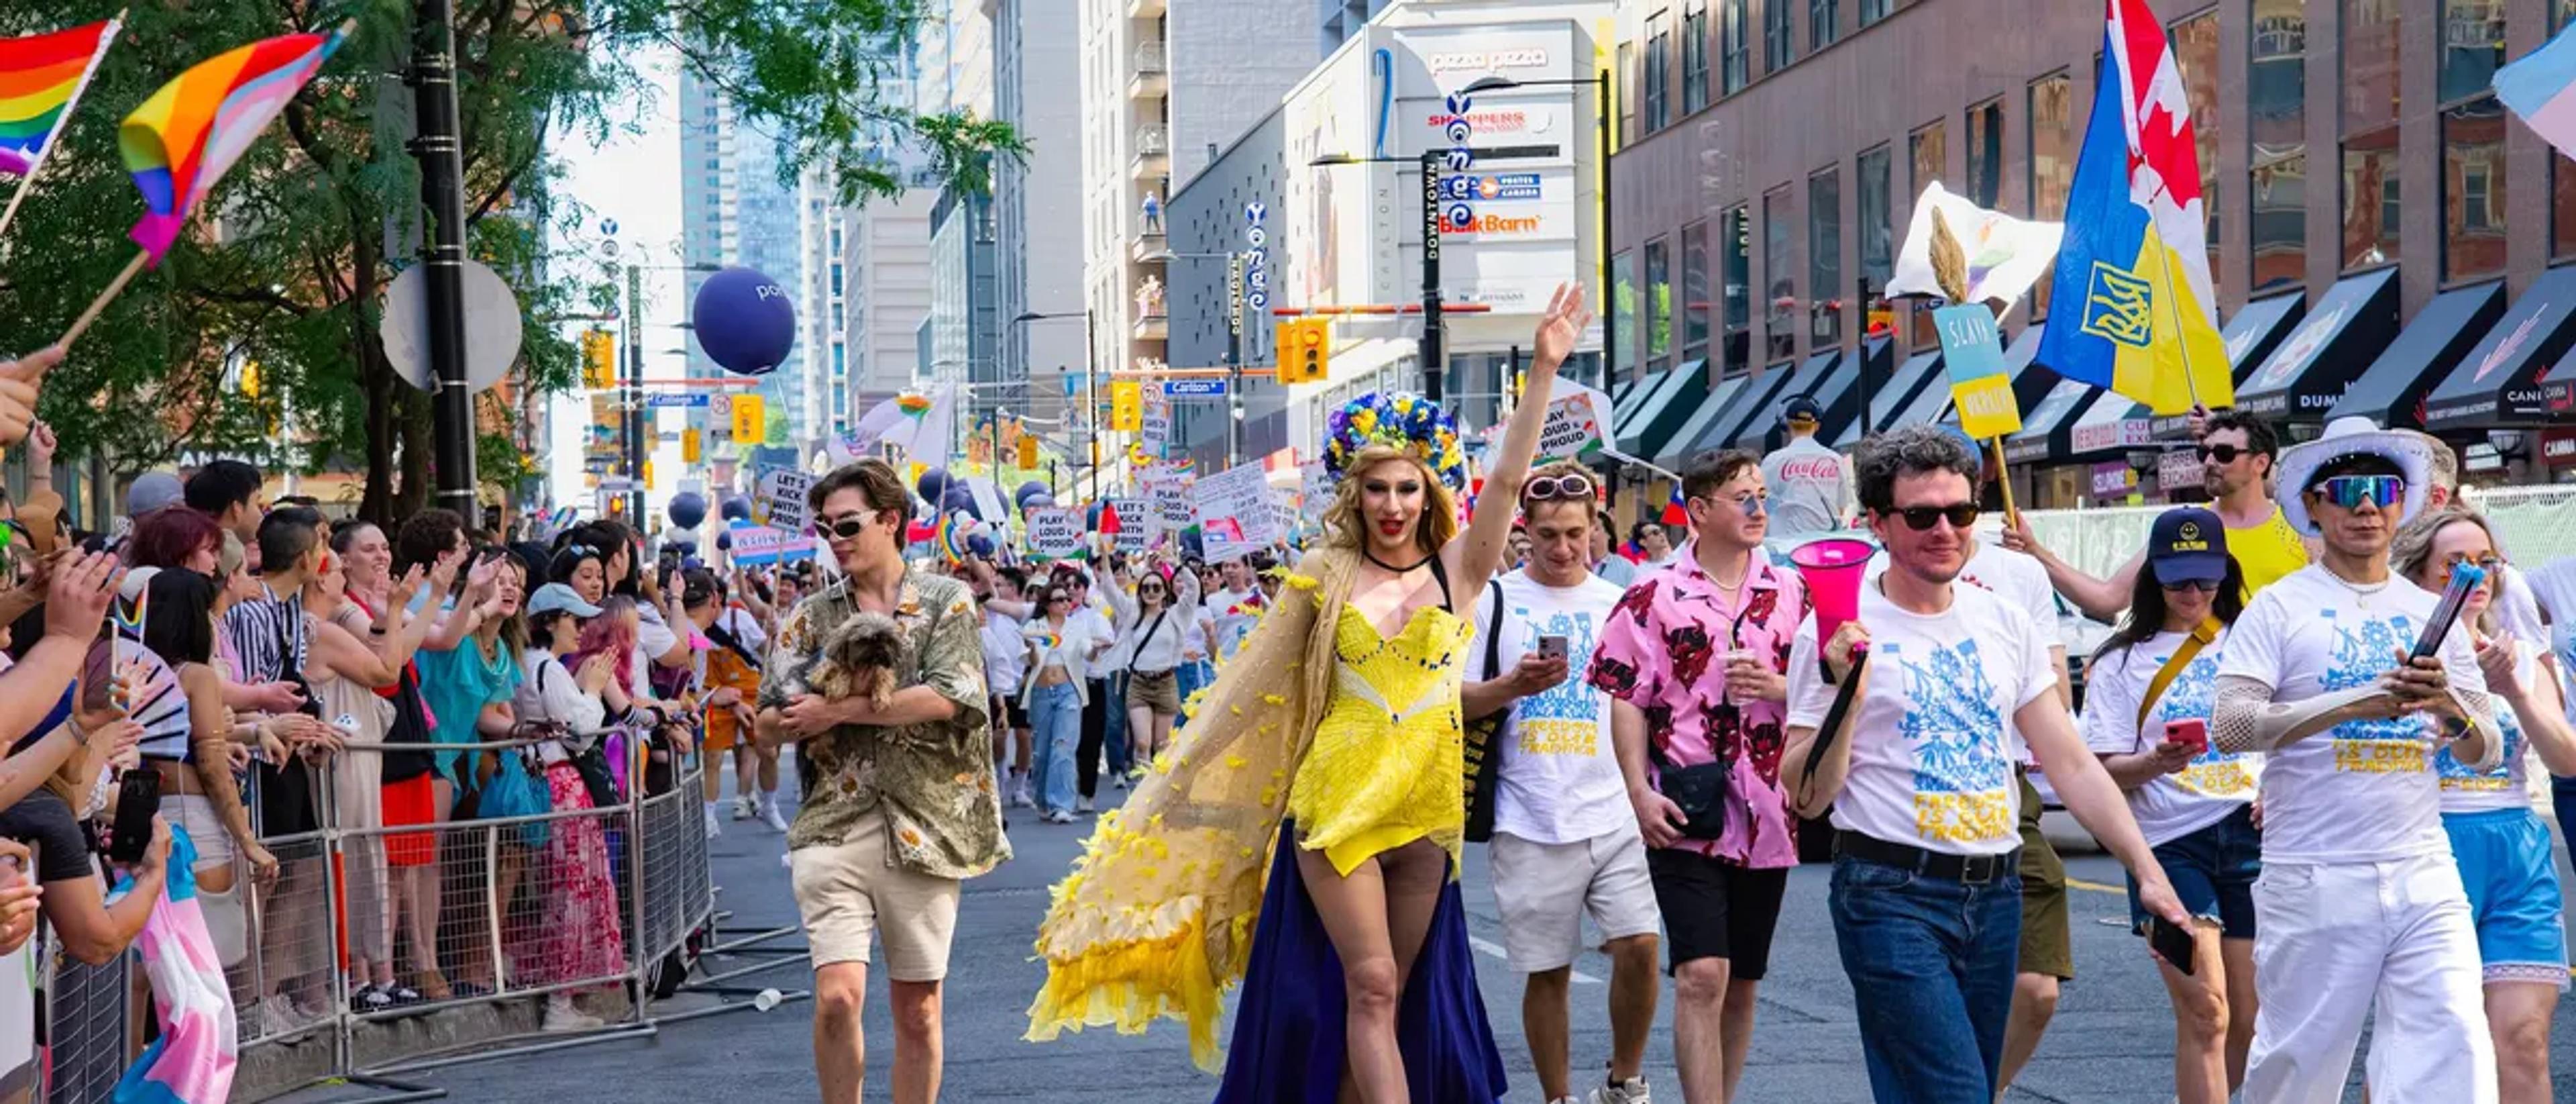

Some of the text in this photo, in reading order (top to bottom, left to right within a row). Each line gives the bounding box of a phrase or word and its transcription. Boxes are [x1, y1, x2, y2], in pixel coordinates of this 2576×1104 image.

[1428, 112, 1525, 126] SHPPERS
[1447, 91, 1472, 227] Yonge
[1427, 163, 1438, 259] DOWNTOWN
[1485, 214, 1537, 232] Barn
[1246, 201, 1268, 311] Yonge
[1232, 258, 1240, 335] DOWNTOWN
[1172, 381, 1210, 393] Carlton
[1541, 431, 1585, 451] PROUD
[777, 487, 802, 501] KICK
[773, 499, 802, 514] WITH
[769, 511, 802, 527] PRIDE
[1040, 515, 1065, 525] PLAY
[1040, 528, 1065, 537] LOUD
[1040, 538, 1075, 548] PROUD
